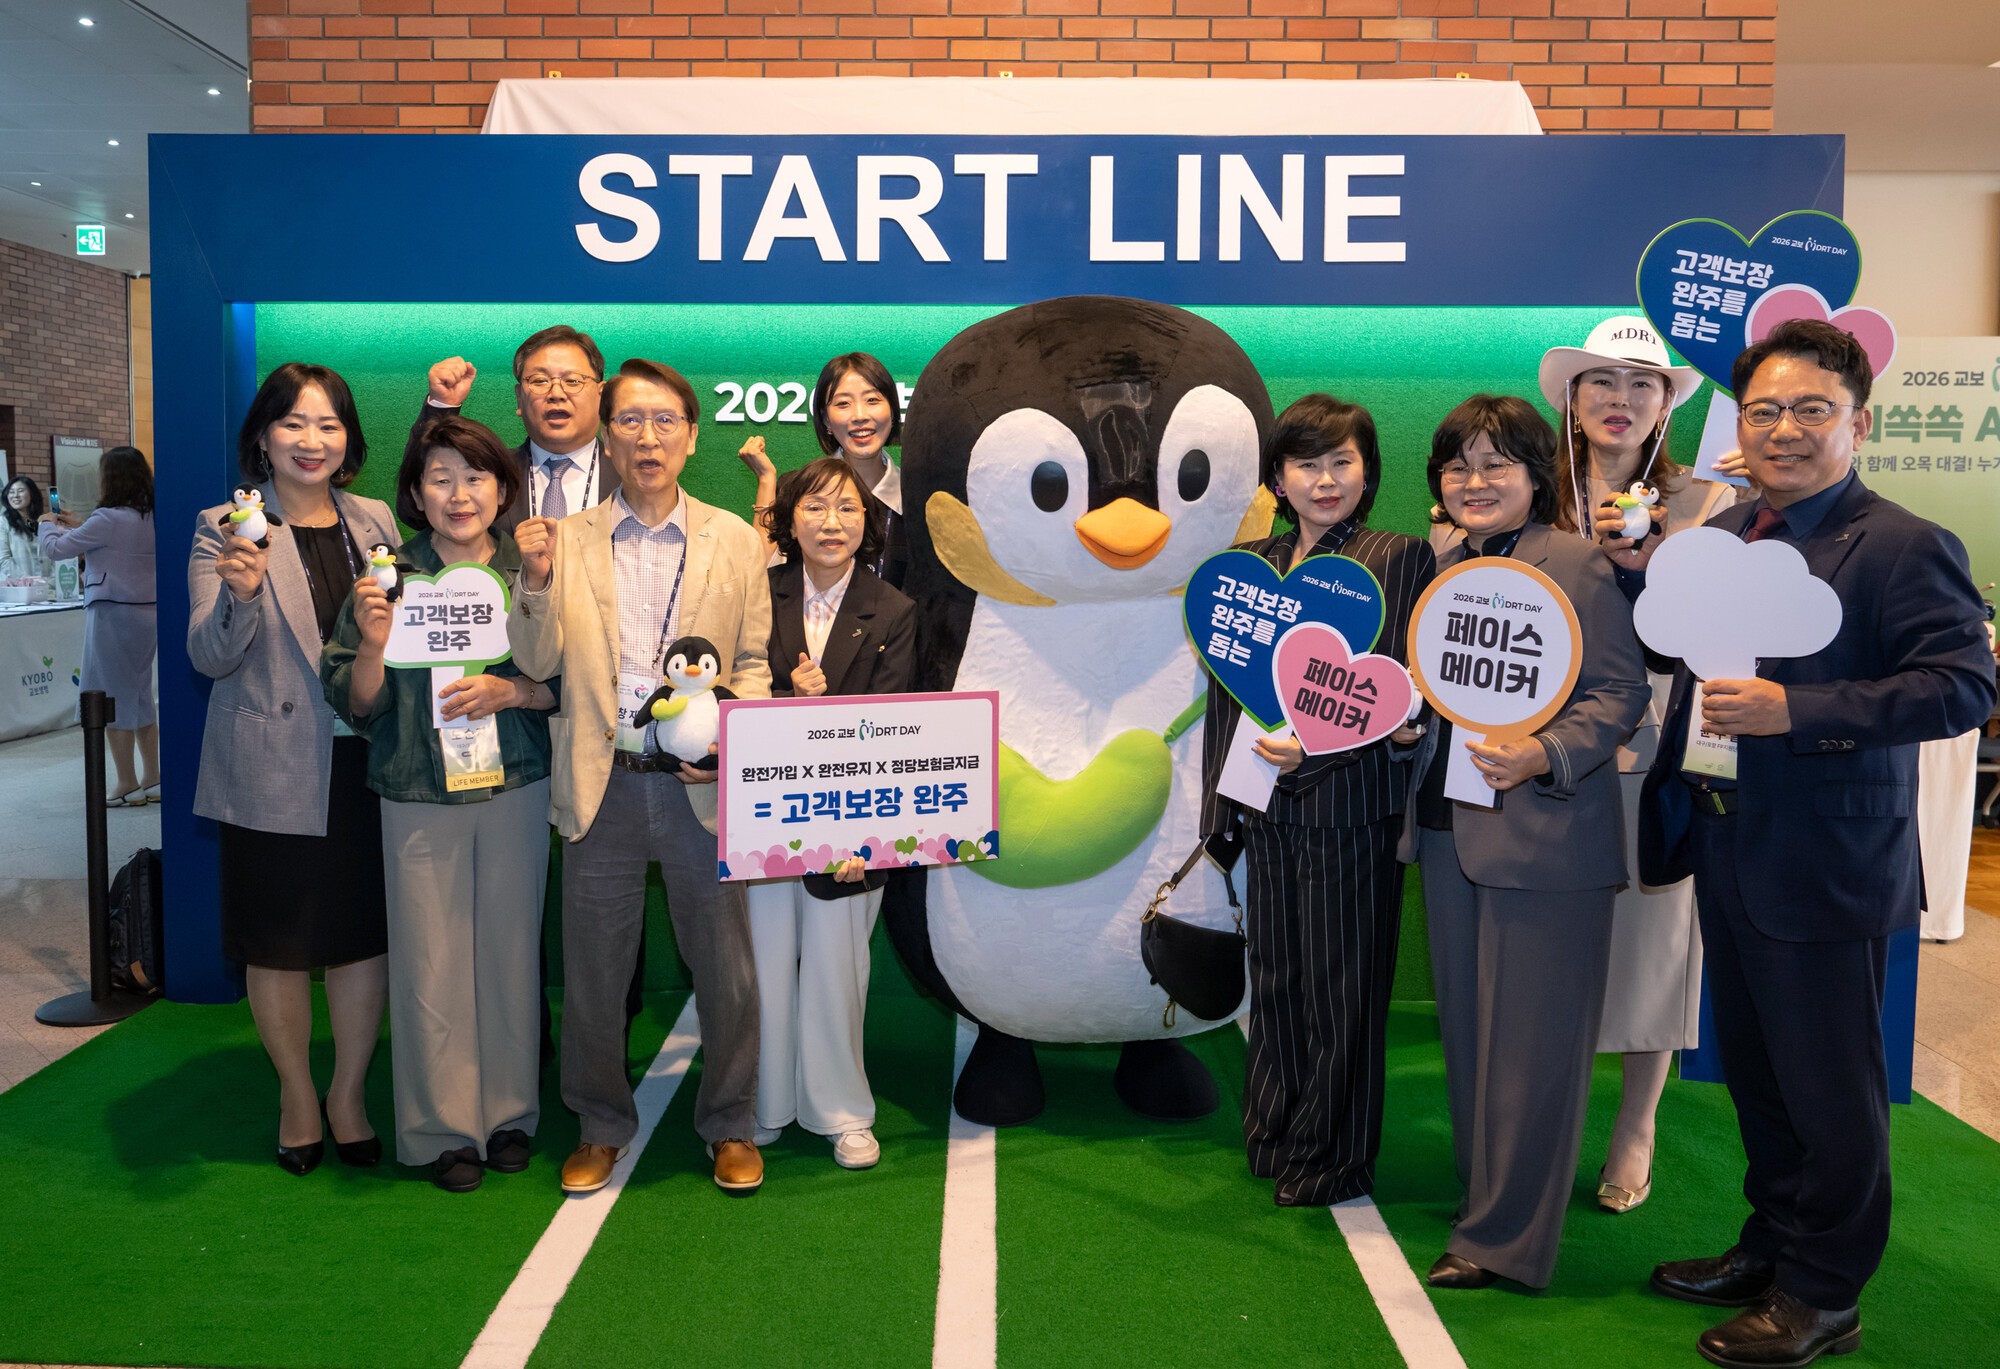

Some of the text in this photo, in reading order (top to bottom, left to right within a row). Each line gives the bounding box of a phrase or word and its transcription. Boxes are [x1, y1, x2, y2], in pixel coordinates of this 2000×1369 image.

[575, 153, 1406, 263] START LINE
[1772, 237, 1790, 246] 2026
[1790, 239, 1804, 249] 교보
[1831, 247, 1848, 256] DAY
[1671, 249, 1774, 289] 고객보장
[1672, 281, 1747, 317] 완주를
[1670, 312, 1721, 343] 돕는
[1902, 371, 1949, 386] 2026
[1953, 371, 1985, 387] 교보
[714, 381, 816, 423] 202
[1867, 456, 1897, 472] 함께
[1901, 456, 1932, 472] 오목
[1937, 456, 1972, 472] 대결!
[1212, 575, 1302, 623] 고객보장
[1301, 575, 1319, 586] 2026
[1318, 580, 1331, 590] 교보
[1356, 592, 1372, 603] DAY
[1453, 593, 1474, 603] 2026
[1475, 596, 1490, 606] 교보
[1524, 603, 1543, 613] DAY
[403, 603, 494, 627] 고객보장
[1211, 603, 1277, 646] 완주를
[427, 630, 472, 652] 완주
[1207, 632, 1252, 667] 돕는
[1444, 611, 1543, 658] 페이스
[21, 671, 53, 687] KYOBO
[1303, 657, 1378, 705] 페이스
[1440, 651, 1539, 699] 메이커
[1294, 687, 1371, 736] 메이커
[807, 729, 835, 740] 2026
[837, 728, 856, 739] 교보
[899, 725, 921, 736] DAY
[453, 775, 499, 787] LIFE MEMBER
[741, 755, 980, 783] 완전가입 X 완전유지 X 정당보험금지급
[781, 786, 903, 824] 고객보장
[913, 782, 968, 815] 완주
